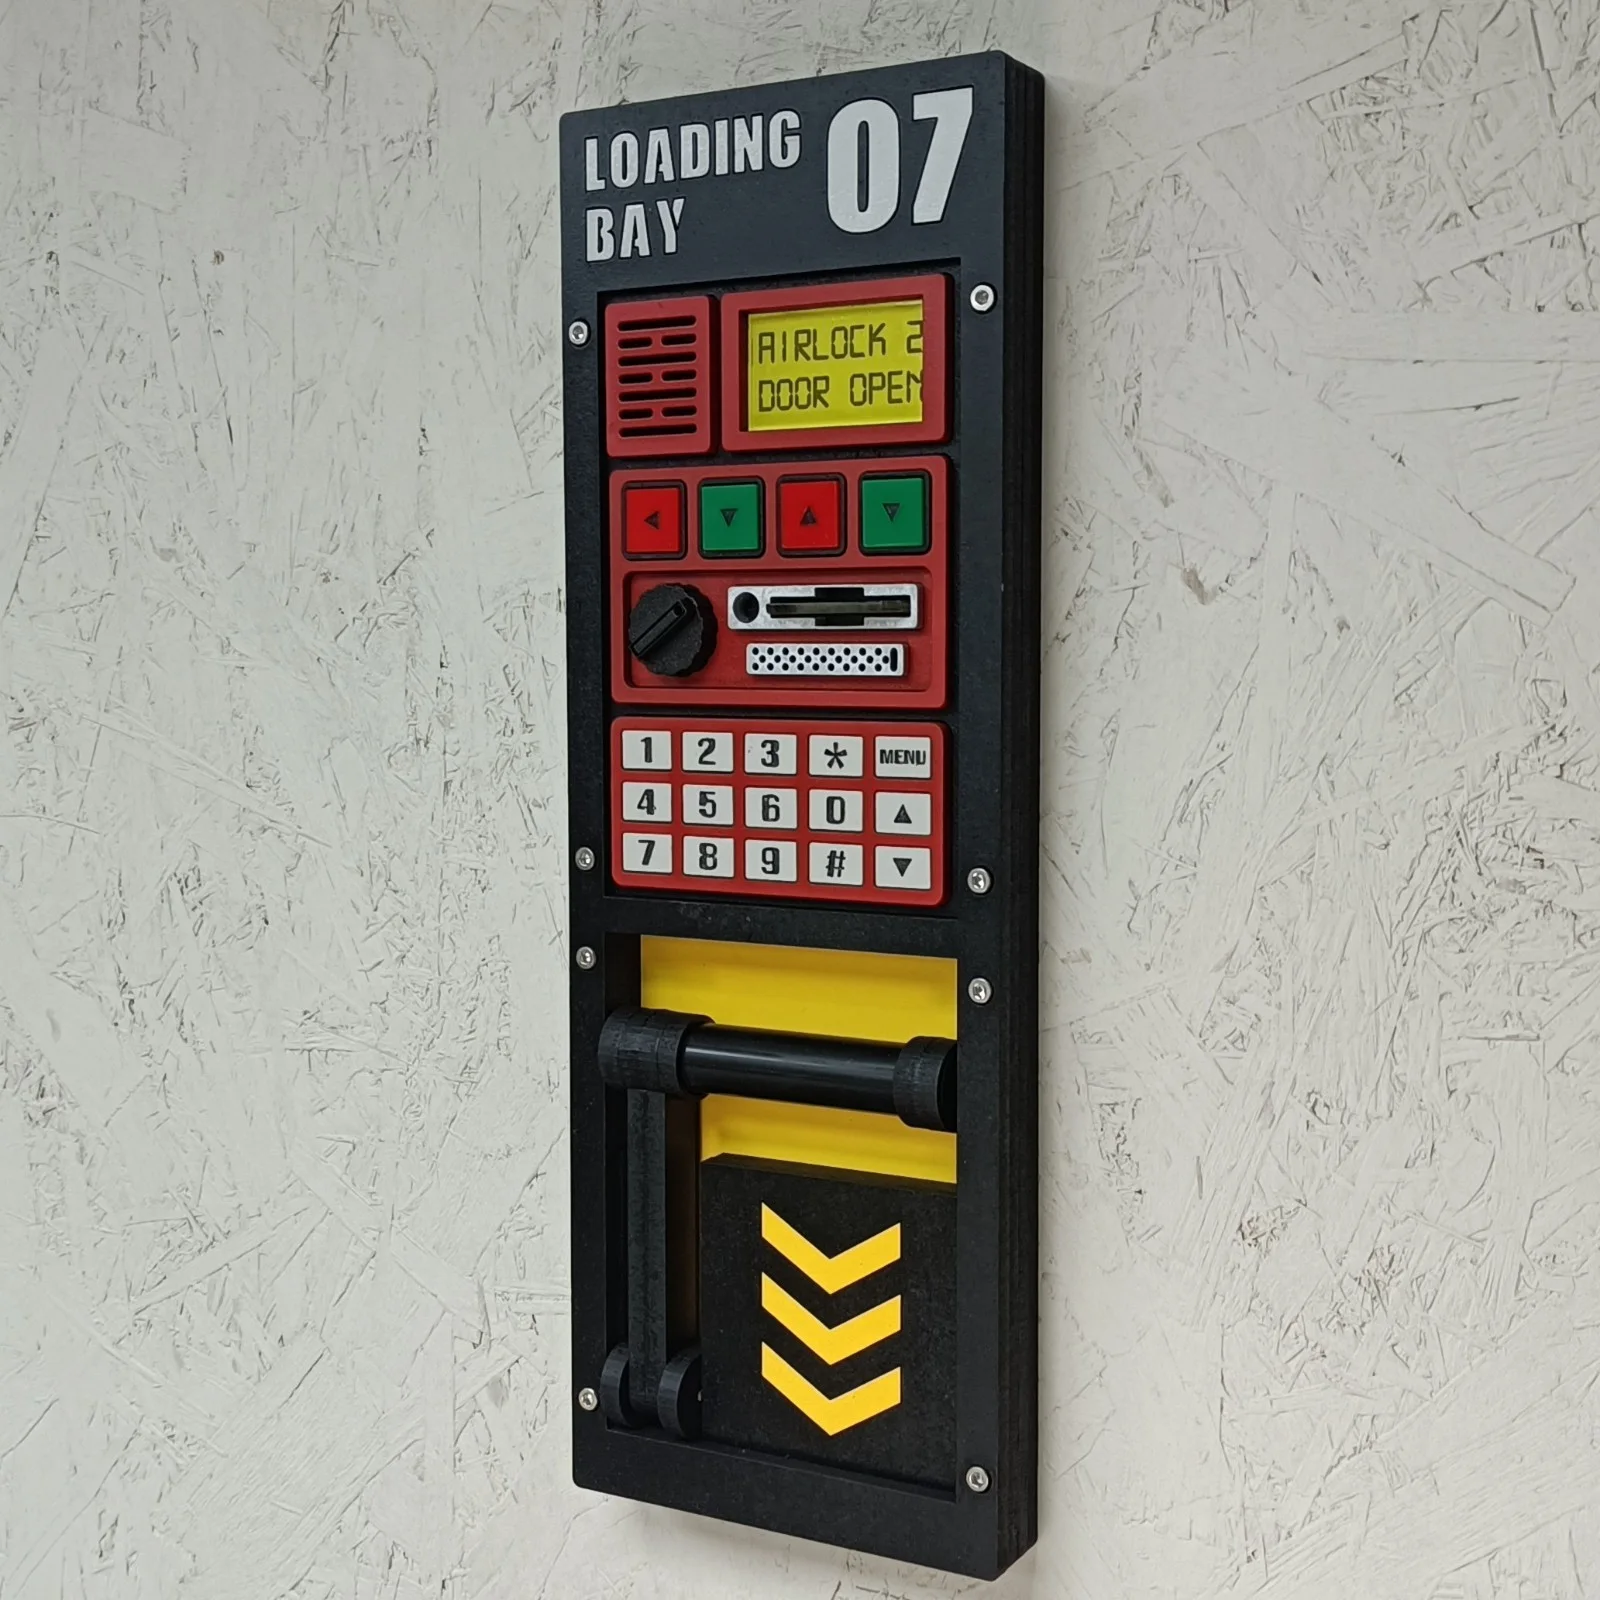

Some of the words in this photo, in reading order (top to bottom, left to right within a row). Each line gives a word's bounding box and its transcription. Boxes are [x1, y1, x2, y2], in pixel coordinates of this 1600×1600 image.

[586, 110, 801, 191] LOADING
[827, 86, 973, 233] 07
[586, 199, 684, 262] BAY
[758, 323, 886, 364] AIRLOCK
[907, 320, 923, 353] 2
[759, 376, 829, 412] DOOR
[850, 370, 923, 406] OPEN
[640, 737, 652, 763] 1
[698, 738, 716, 765] 2
[761, 740, 779, 767] 3
[880, 749, 926, 766] MENU
[637, 789, 656, 815] 4
[699, 791, 716, 818] 5
[762, 794, 780, 822] 6
[826, 796, 845, 824] 0
[638, 840, 655, 866] 7
[700, 842, 717, 870] 8
[761, 847, 779, 875] 9
